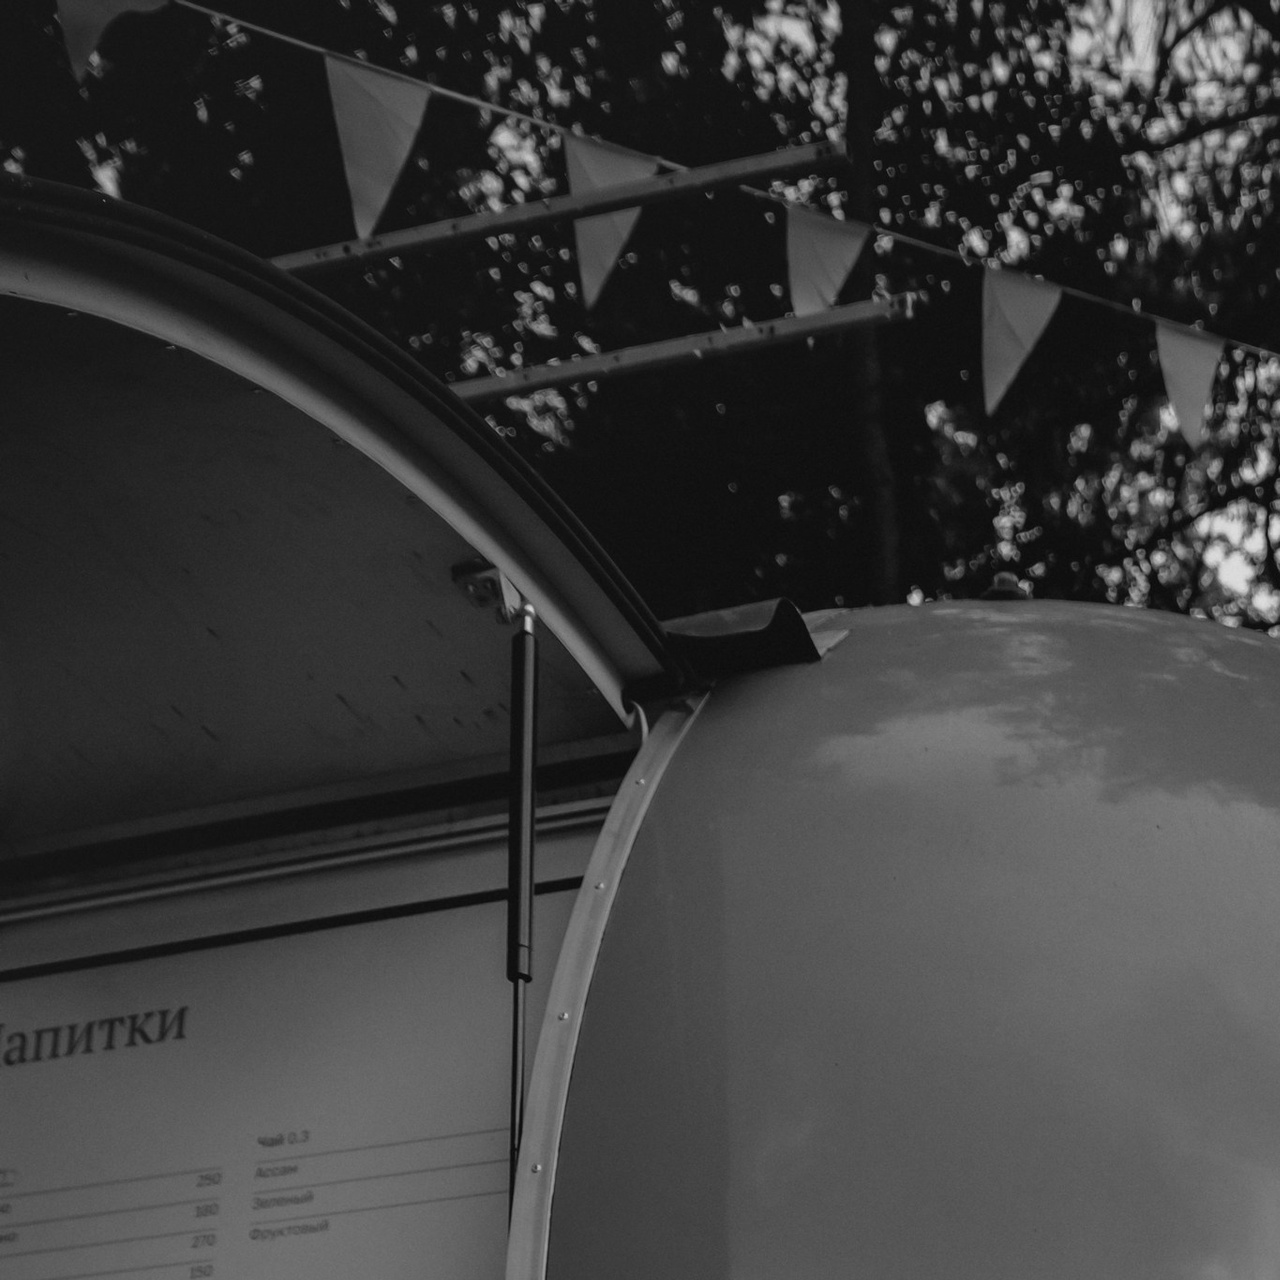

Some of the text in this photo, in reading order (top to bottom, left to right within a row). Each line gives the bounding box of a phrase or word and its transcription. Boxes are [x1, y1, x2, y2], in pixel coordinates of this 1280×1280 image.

[0, 1004, 188, 1067] апитки
[254, 1164, 298, 1178] Ассам
[248, 1219, 329, 1241] Фруктовый
[191, 1233, 217, 1248] 270
